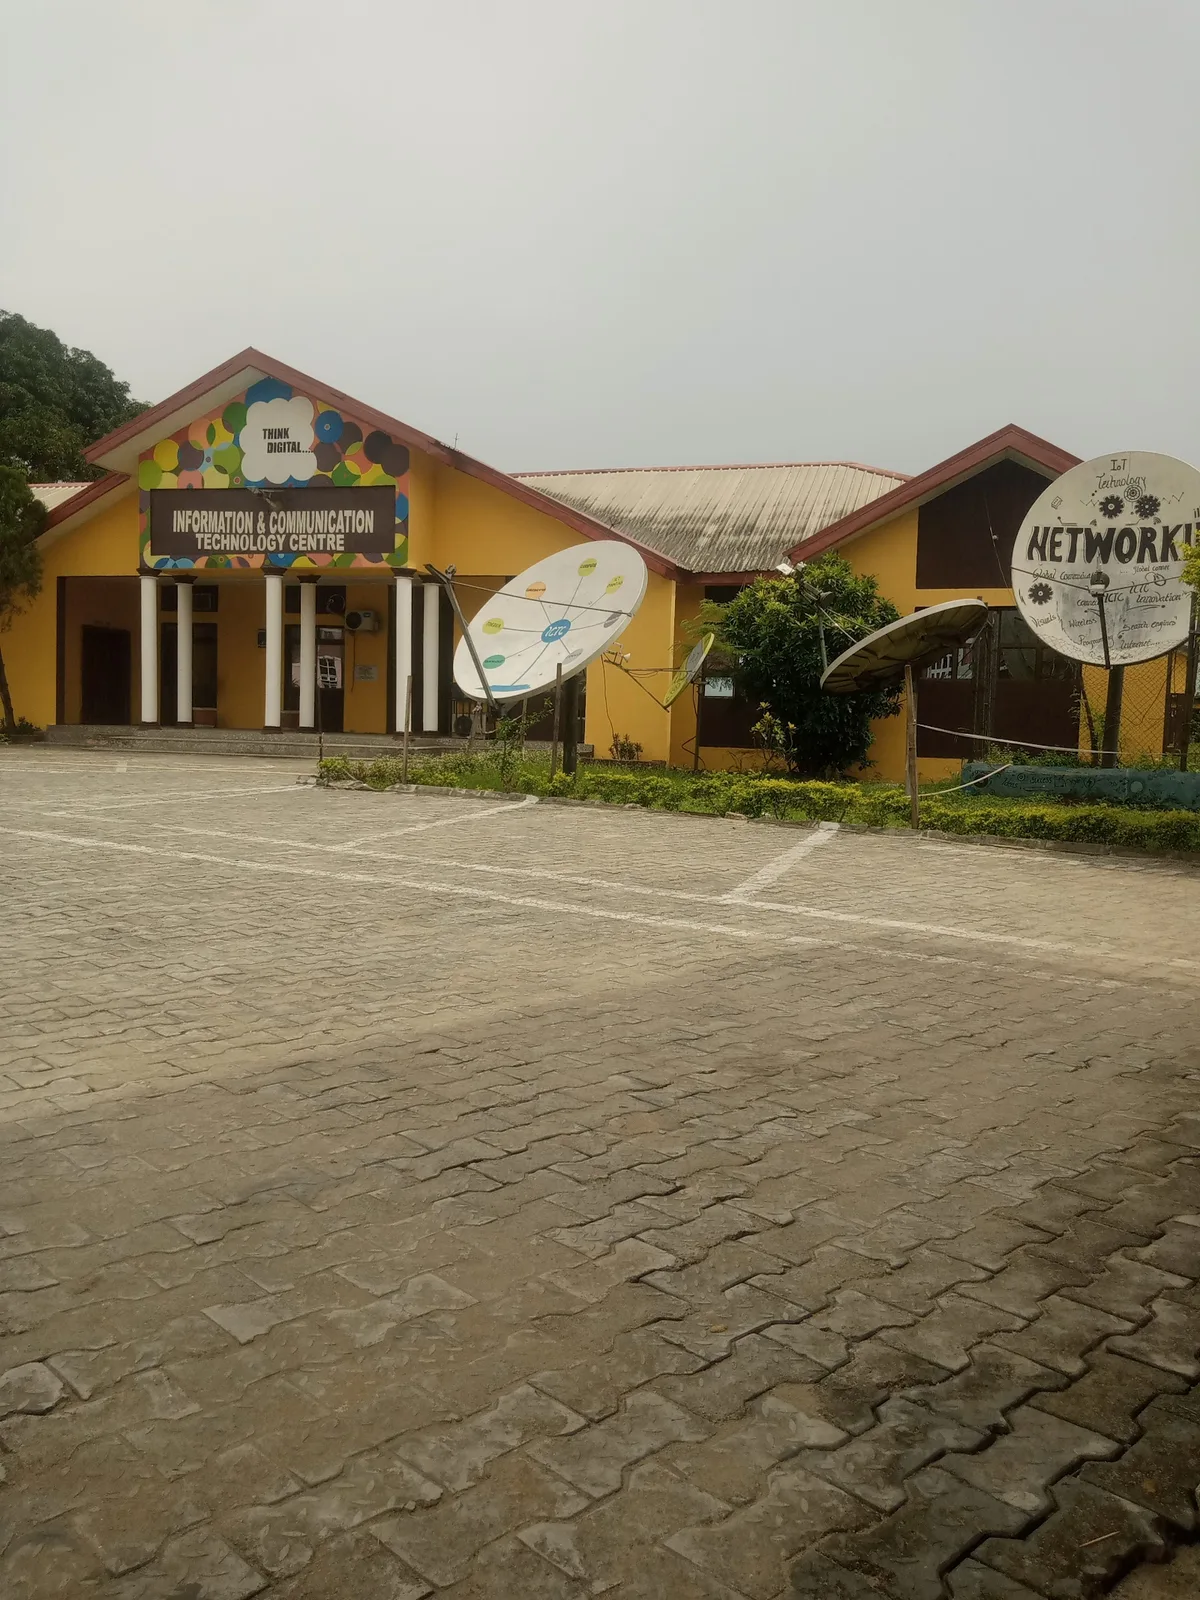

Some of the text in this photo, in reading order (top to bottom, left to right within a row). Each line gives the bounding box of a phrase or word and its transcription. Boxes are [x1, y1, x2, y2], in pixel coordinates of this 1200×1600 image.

[262, 427, 290, 440] THINK
[1110, 459, 1128, 471] IoT
[1096, 473, 1146, 491] Technology
[172, 509, 374, 534] INFORMATION & COMMUNICATION
[195, 533, 345, 551] TECHNOLOGY CENTRE
[1027, 522, 1200, 564] NETWORKI
[1104, 592, 1124, 603] ICTC
[1068, 618, 1098, 628] Wireless
[544, 624, 567, 637] ICTC
